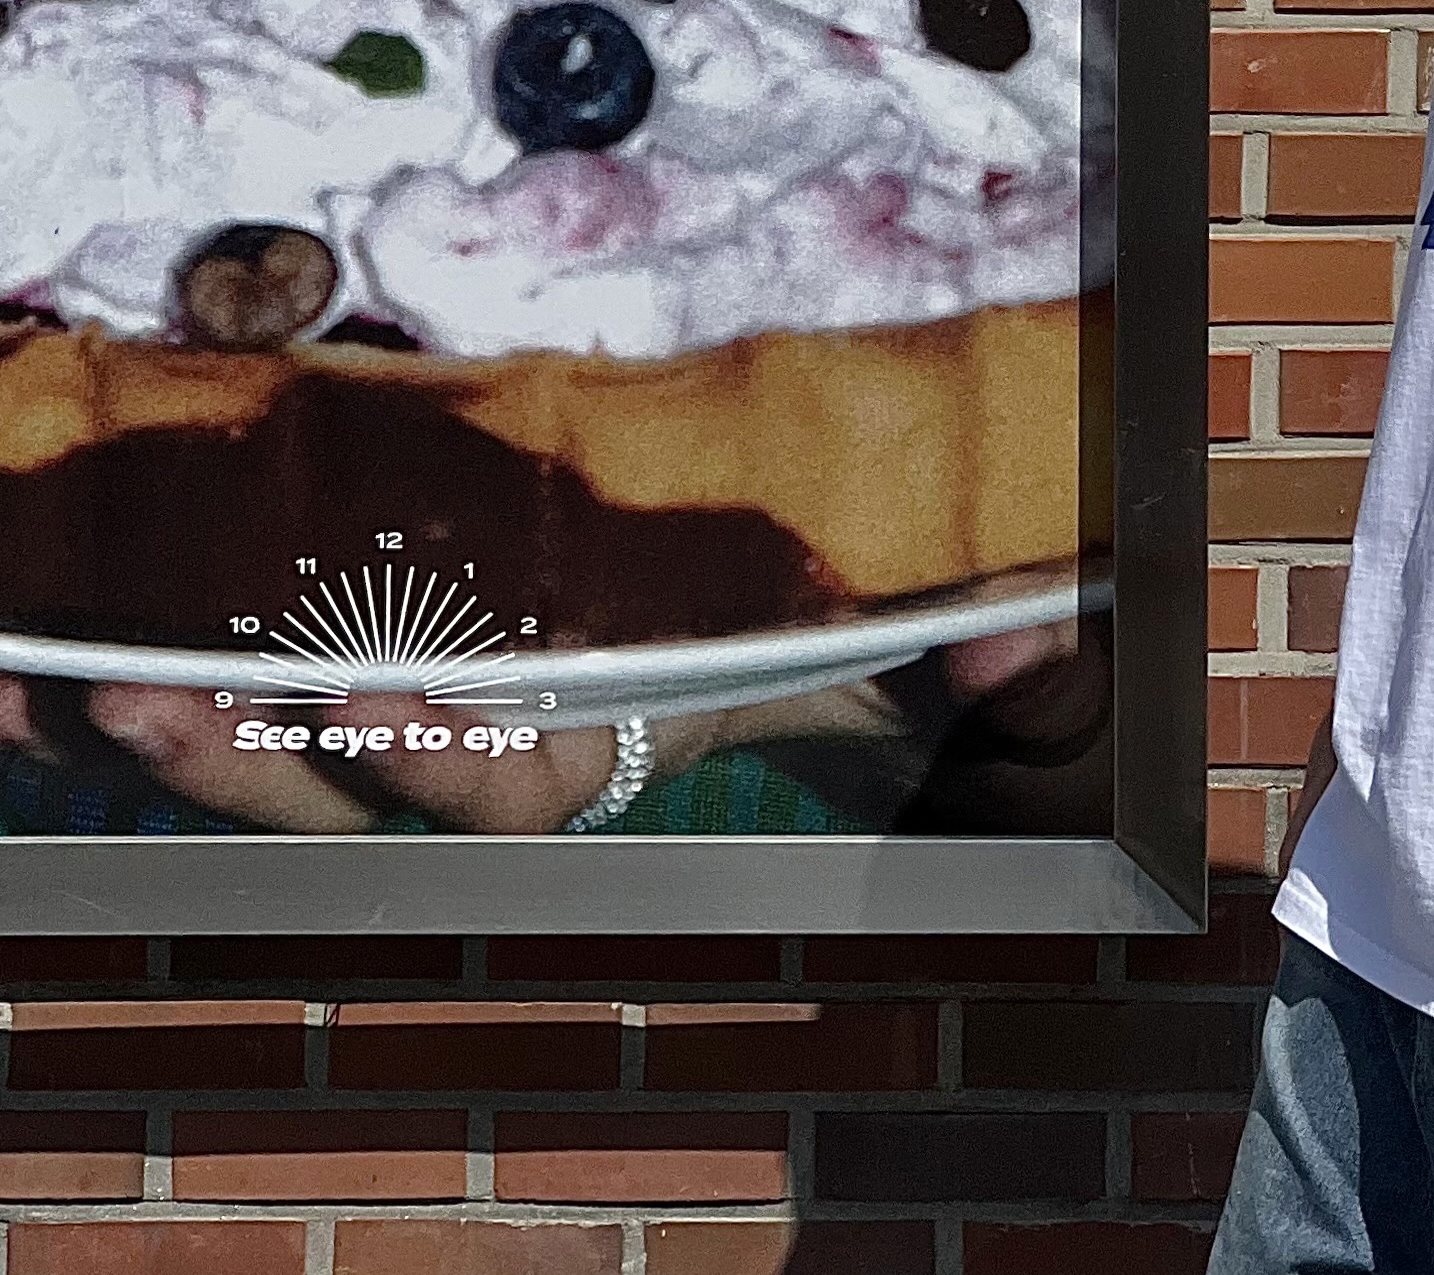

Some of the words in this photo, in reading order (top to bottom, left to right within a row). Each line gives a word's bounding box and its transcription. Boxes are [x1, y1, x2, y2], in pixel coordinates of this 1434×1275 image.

[375, 532, 403, 549] 12
[295, 558, 316, 574] 11
[463, 562, 474, 579] 1
[229, 616, 260, 634] 10
[520, 617, 538, 634] 2
[214, 691, 234, 709] 9
[539, 692, 557, 710] 3
[232, 720, 311, 751] See
[318, 726, 395, 758] eye
[403, 722, 452, 751] to
[462, 726, 538, 758] eye
